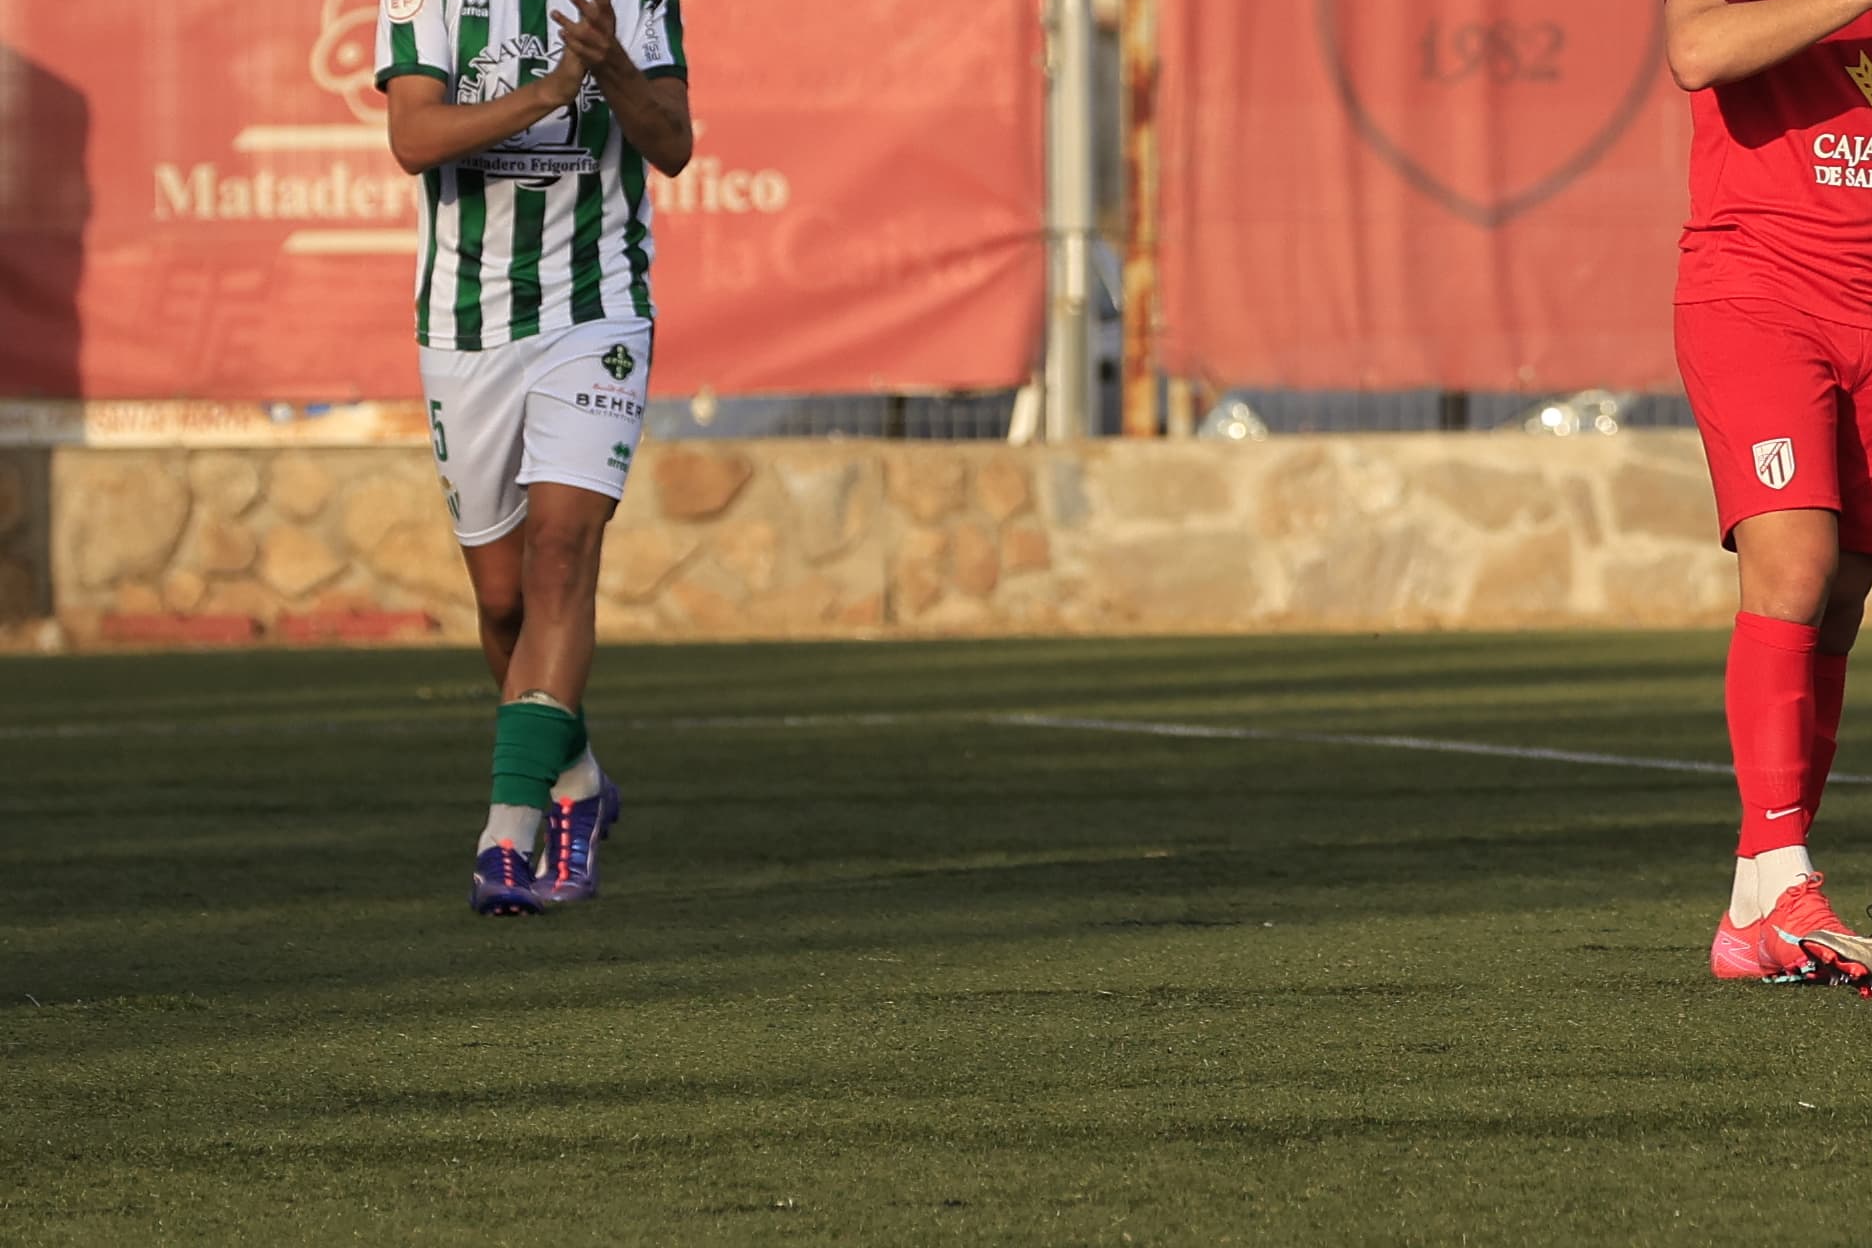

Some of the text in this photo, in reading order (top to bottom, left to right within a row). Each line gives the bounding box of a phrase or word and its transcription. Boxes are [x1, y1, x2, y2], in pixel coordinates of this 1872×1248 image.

[153, 160, 418, 220] Matader
[1814, 165, 1842, 186] DE
[430, 399, 448, 461] 5
